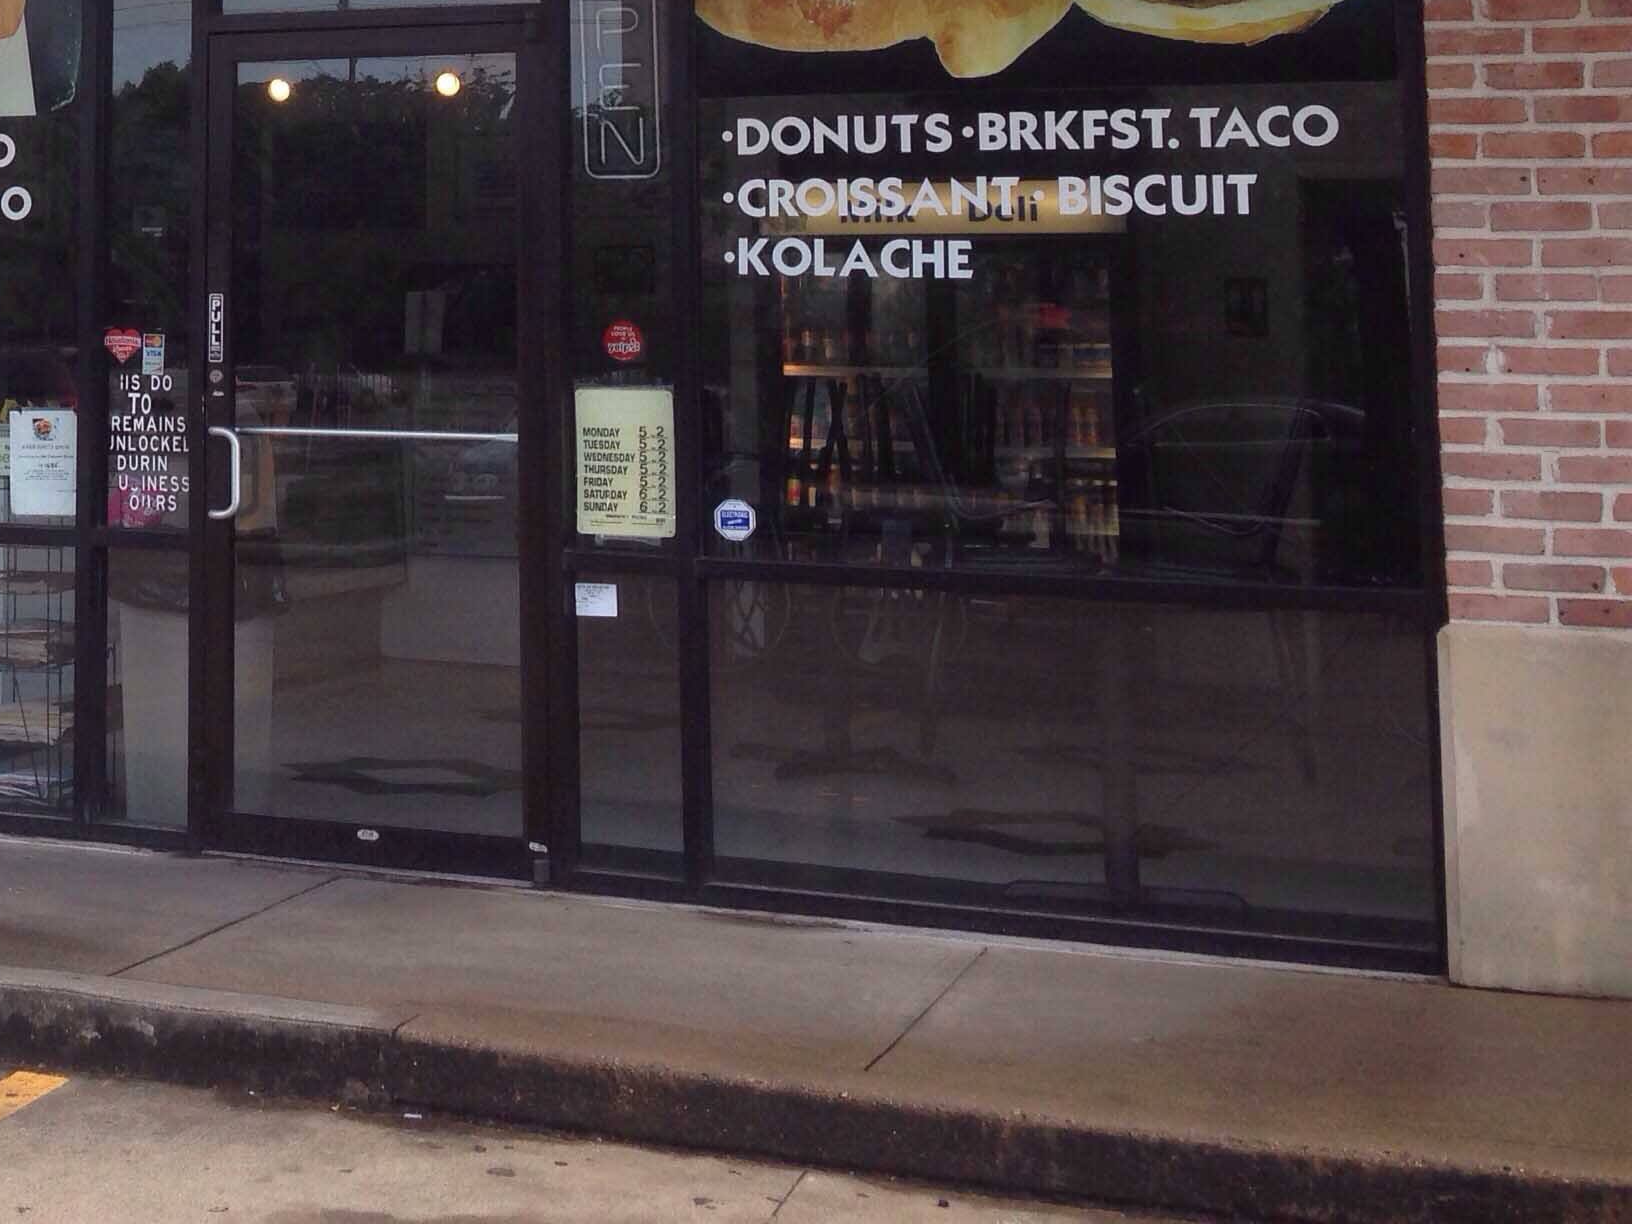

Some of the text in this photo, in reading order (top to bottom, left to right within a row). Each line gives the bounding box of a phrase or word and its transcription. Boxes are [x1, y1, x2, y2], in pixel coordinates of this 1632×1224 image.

[736, 104, 1340, 156] DONUTS BRKFST. TACO
[737, 174, 1258, 219] CROISSANT BISCUIT
[736, 237, 974, 280] KOLACHE
[212, 299, 222, 346] PULL
[128, 392, 152, 414] TO
[111, 416, 186, 432] REMAINS
[583, 427, 620, 437] MONDAY
[656, 425, 665, 437] 2
[583, 439, 621, 450] TUESDAY
[657, 439, 666, 450] 2
[584, 452, 636, 463] WEDNESDAY
[657, 451, 667, 463] 2
[584, 464, 629, 475] THURSDAY
[658, 463, 667, 475] 2
[584, 477, 614, 487] FRIDAY
[658, 476, 667, 488] 2
[584, 489, 628, 500] SATURDAY
[658, 488, 667, 500] 2
[584, 502, 618, 512] SUNDAY
[658, 502, 667, 513] 2
